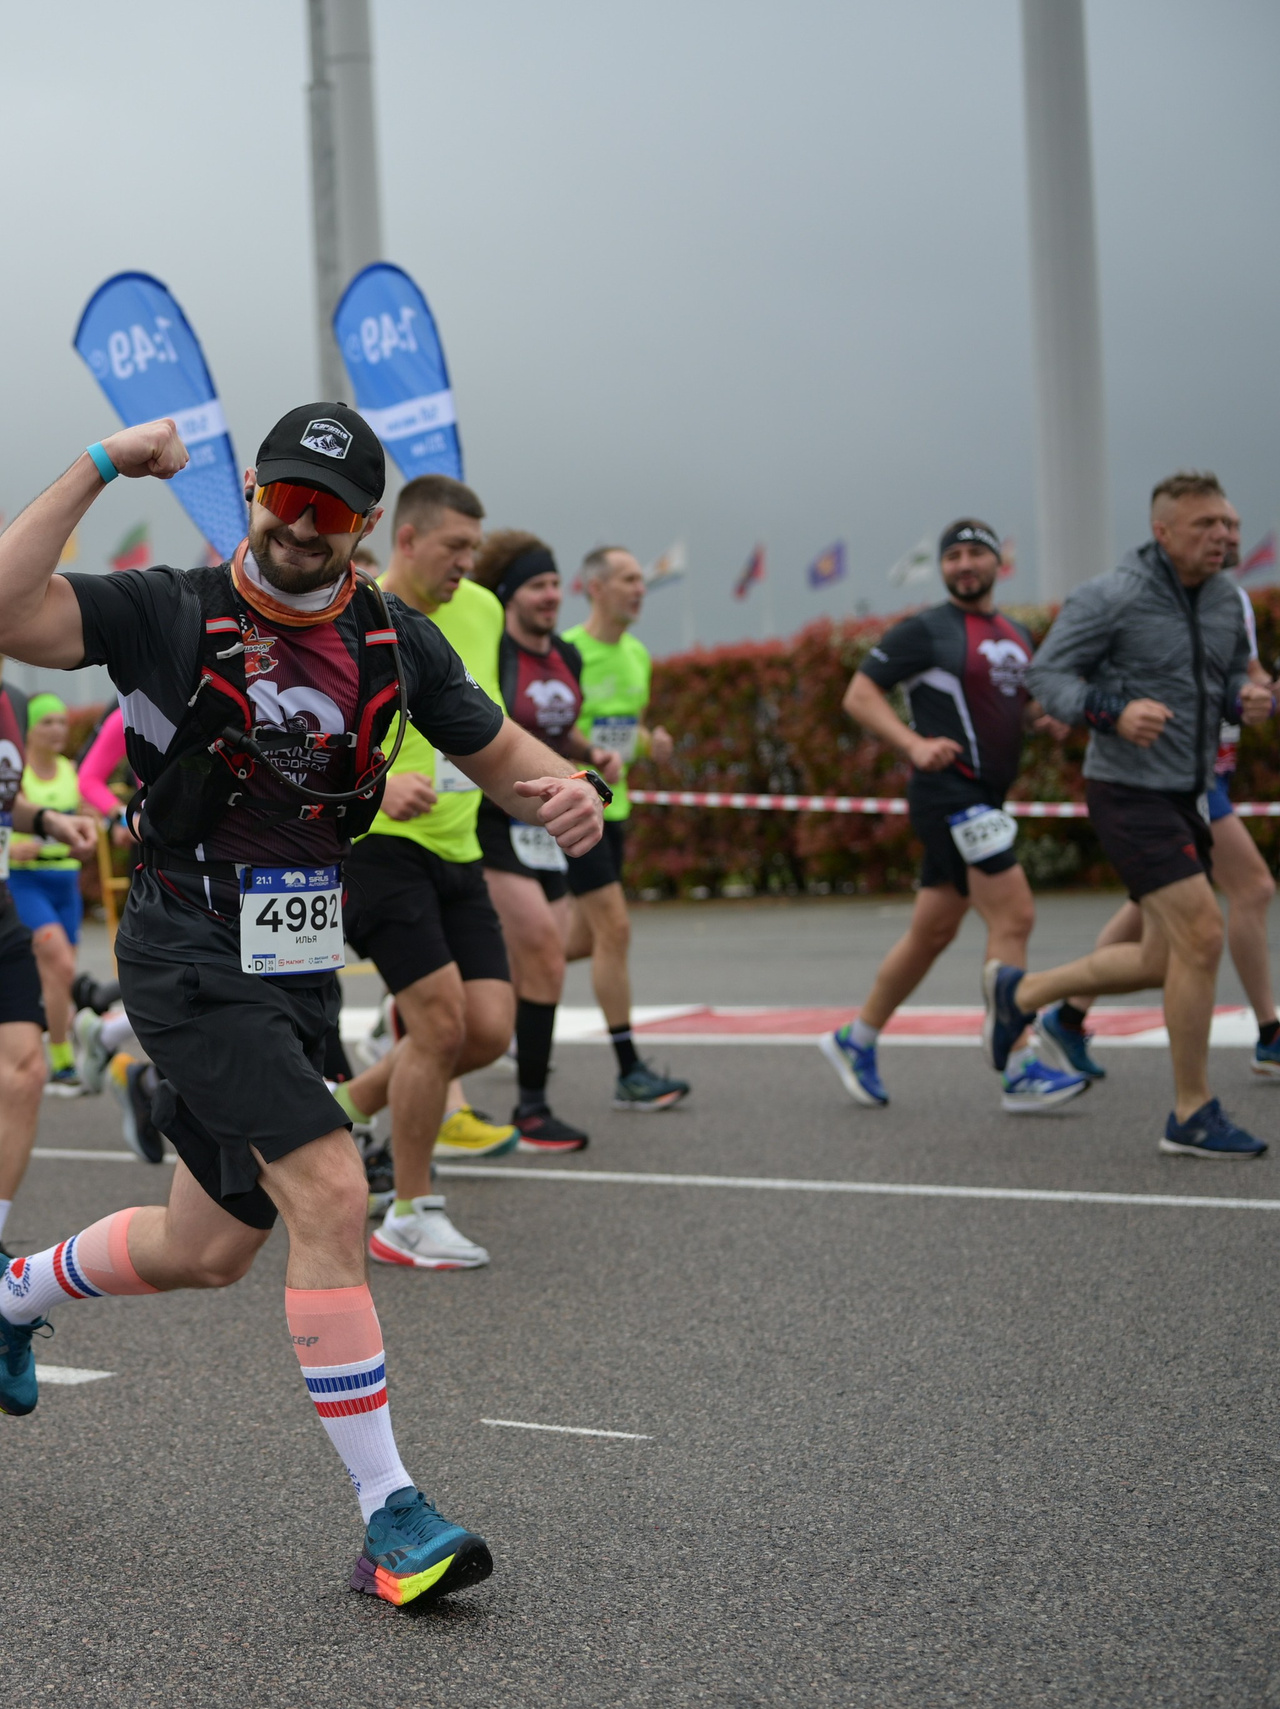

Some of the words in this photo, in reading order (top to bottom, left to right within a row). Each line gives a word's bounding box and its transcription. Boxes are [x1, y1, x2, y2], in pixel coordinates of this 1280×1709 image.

[256, 876, 272, 885] 21.1
[255, 893, 338, 933] 4982
[295, 935, 318, 944] ИЛЬЯ
[255, 960, 264, 971] D
